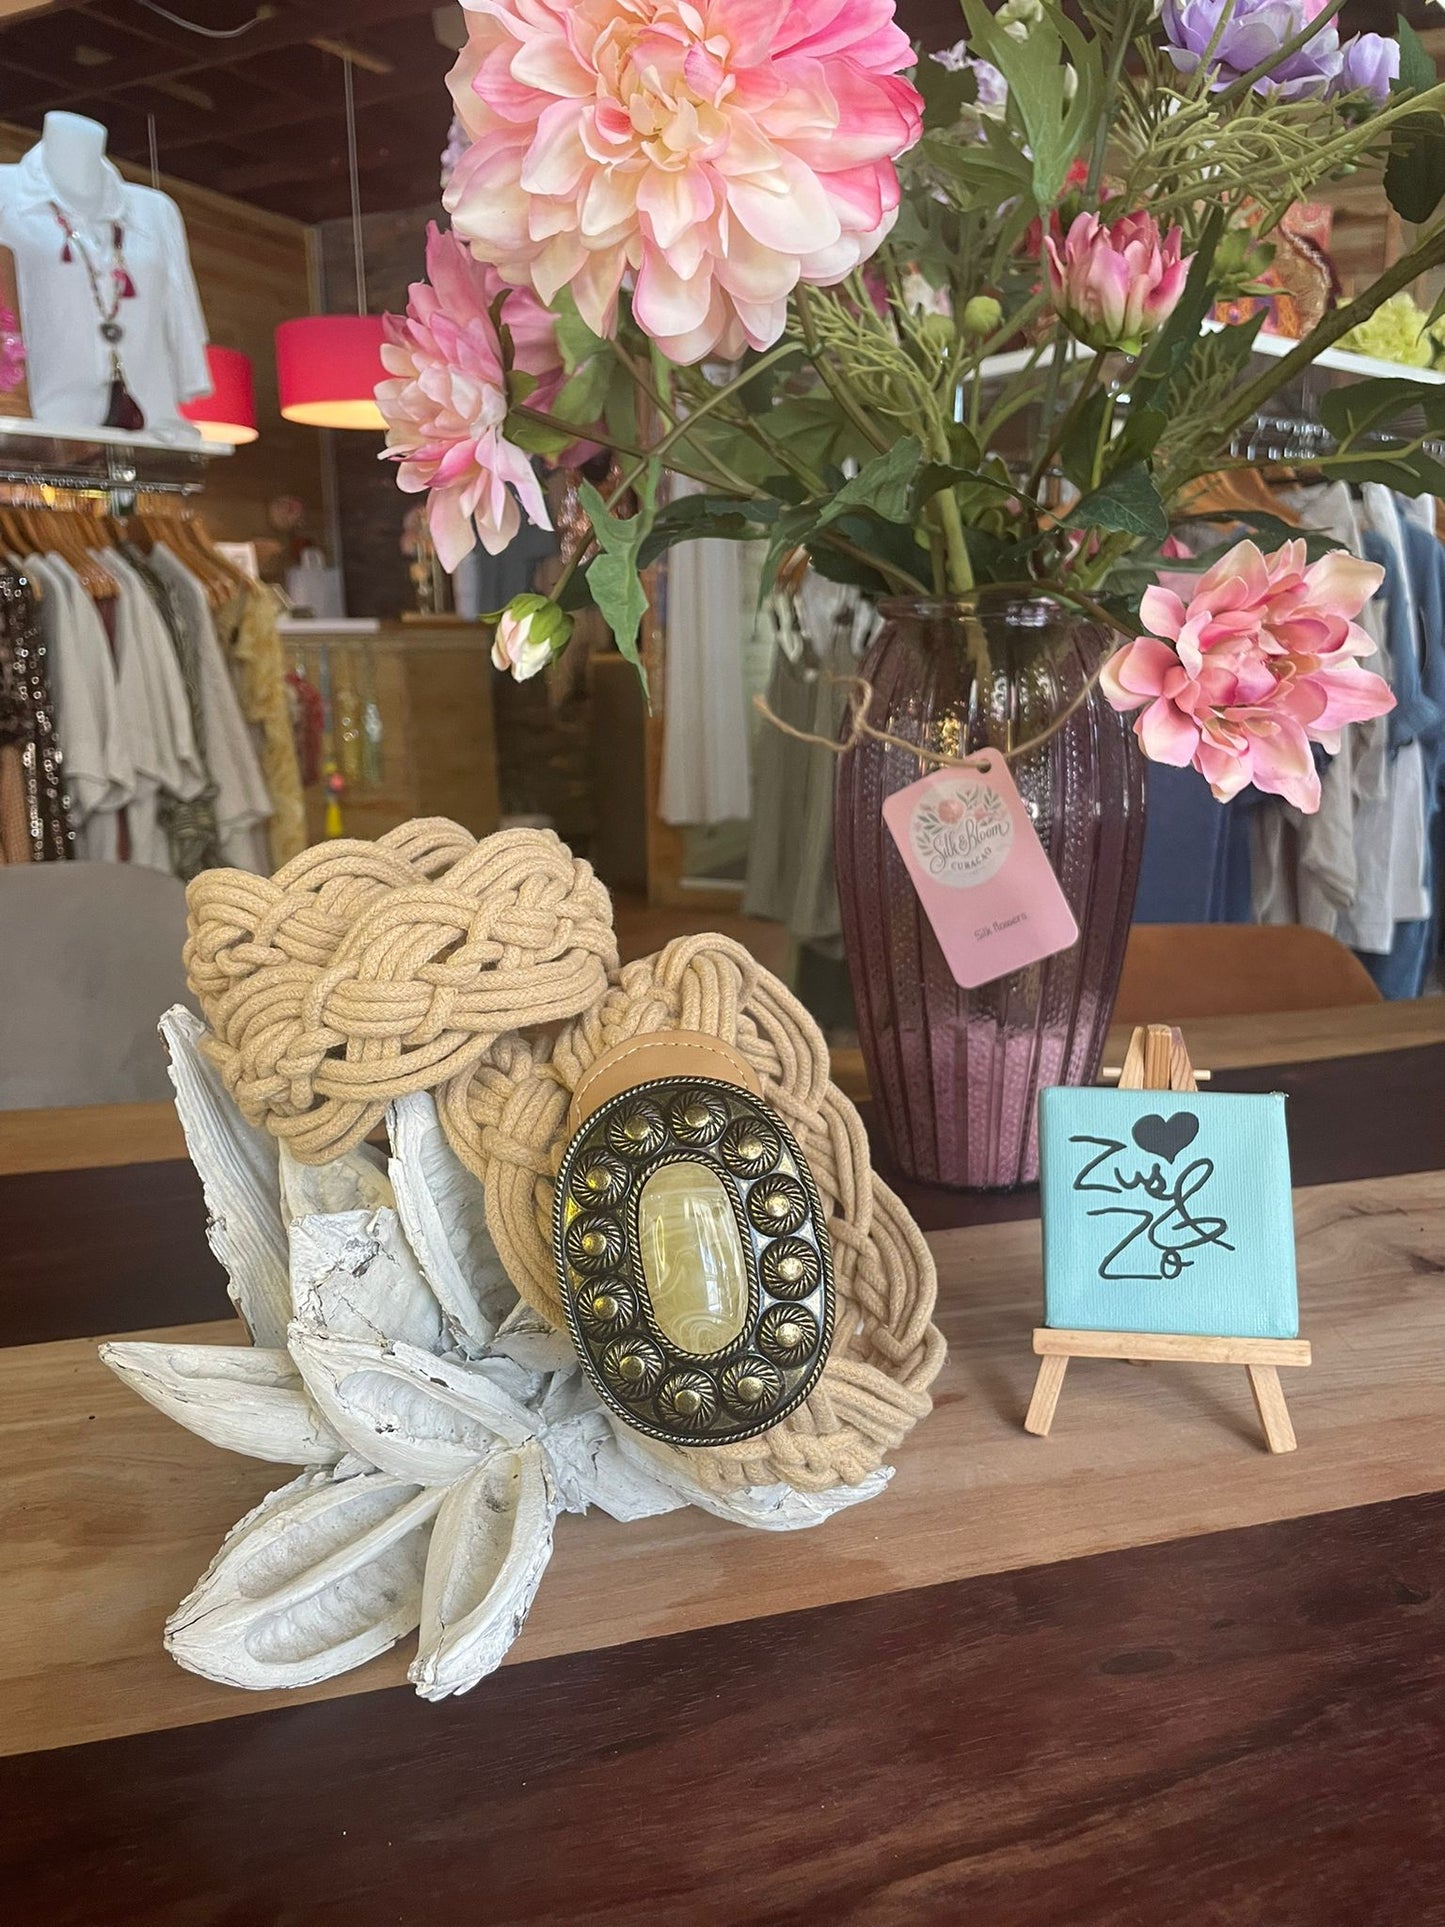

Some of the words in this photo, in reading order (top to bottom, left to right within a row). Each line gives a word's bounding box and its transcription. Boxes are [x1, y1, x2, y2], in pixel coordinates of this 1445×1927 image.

[930, 832, 960, 874] Silk
[958, 834, 968, 852] &
[965, 818, 1010, 857] Bloom
[973, 926, 993, 941] Silk
[992, 912, 1028, 933] flowers
[1068, 1134, 1172, 1201] Zus
[1086, 1206, 1195, 1280] Zo
